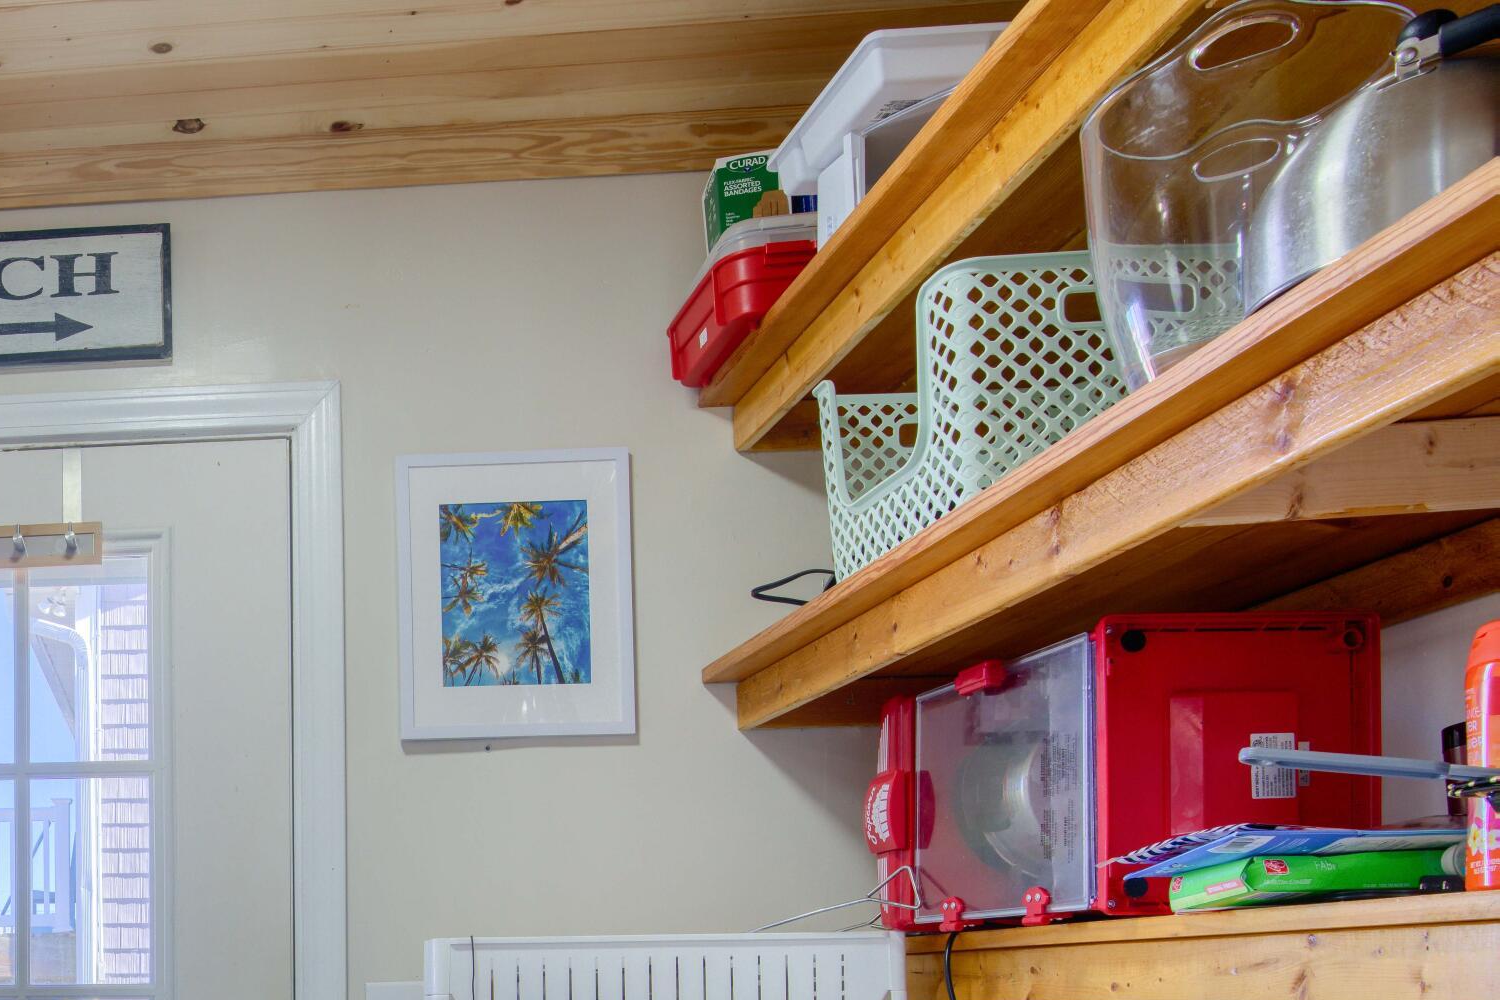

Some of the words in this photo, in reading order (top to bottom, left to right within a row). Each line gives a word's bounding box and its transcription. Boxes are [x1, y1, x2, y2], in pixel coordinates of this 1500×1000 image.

[729, 156, 766, 170] CURAD
[724, 181, 760, 191] ASSORTED
[724, 185, 762, 197] BANDAGES
